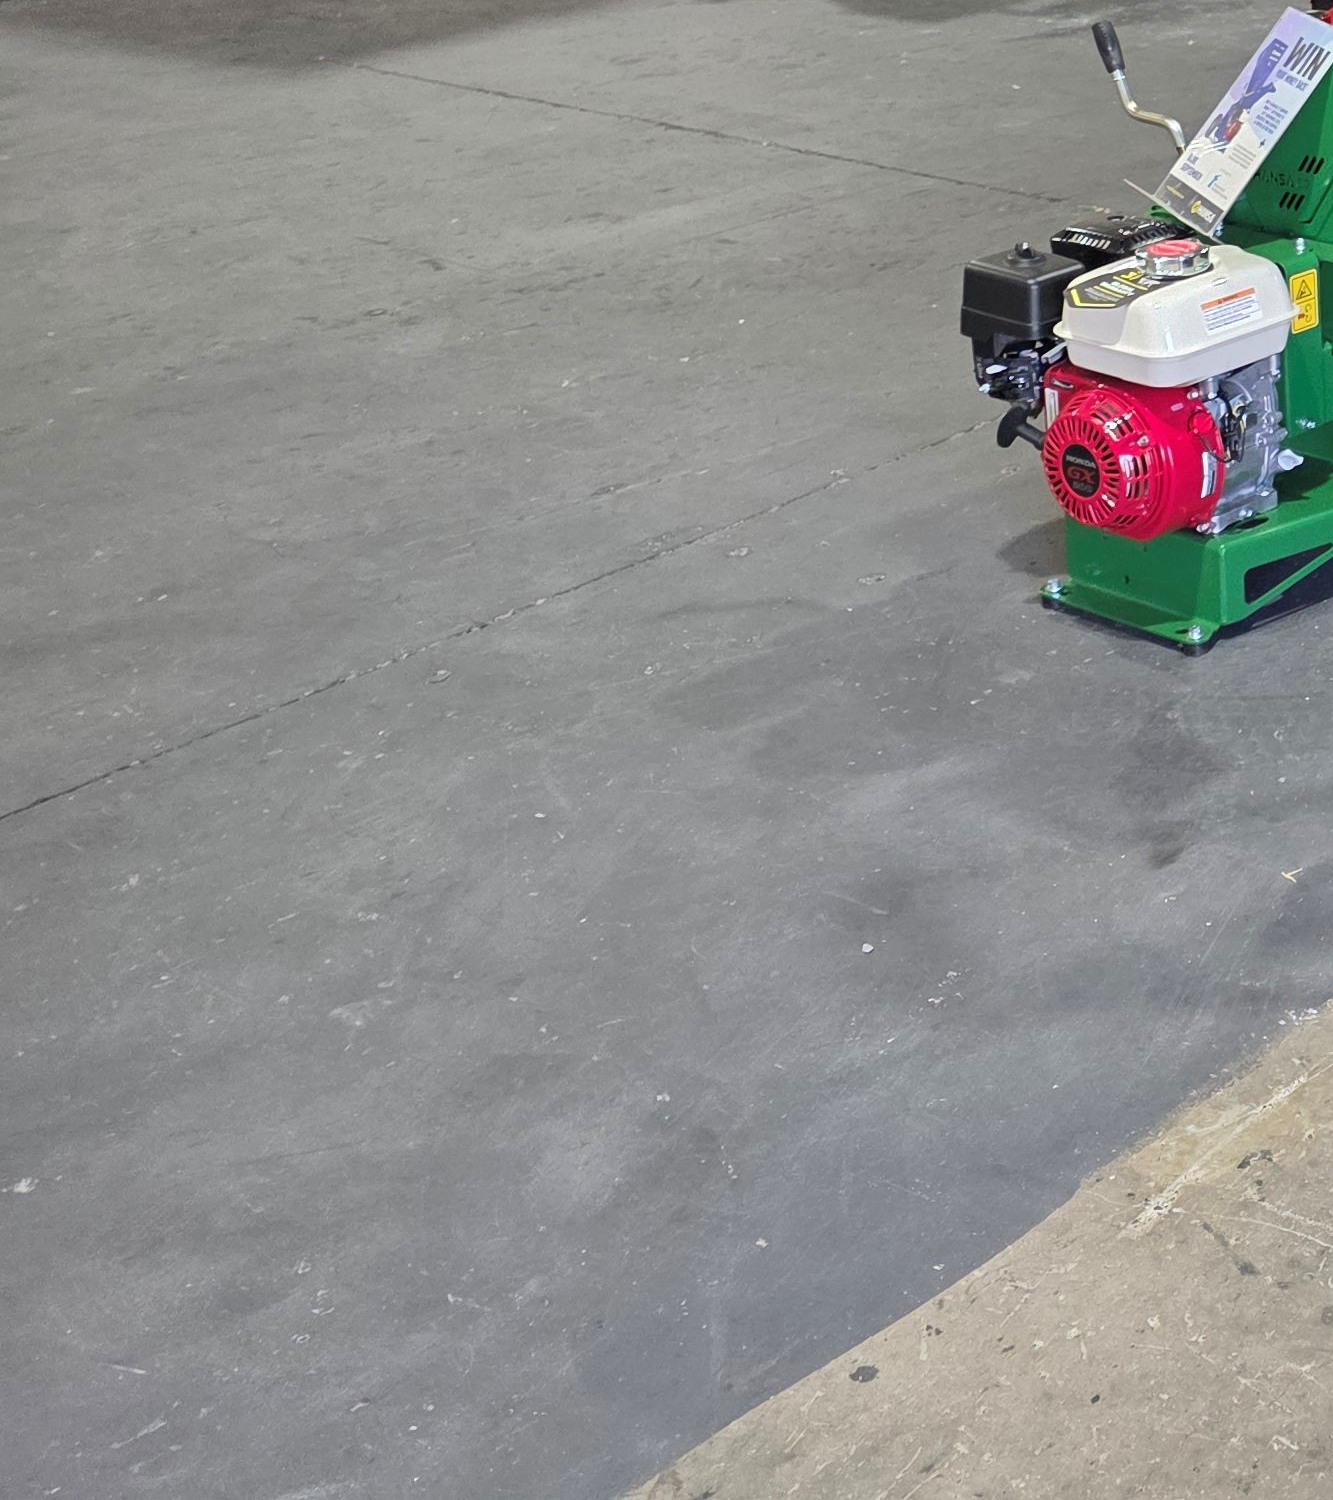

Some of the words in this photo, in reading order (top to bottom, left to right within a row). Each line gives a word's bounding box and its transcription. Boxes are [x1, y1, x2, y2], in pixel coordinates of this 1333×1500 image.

[1282, 36, 1331, 82] WIN
[1065, 454, 1097, 469] HONDA
[1067, 466, 1096, 485] GX
